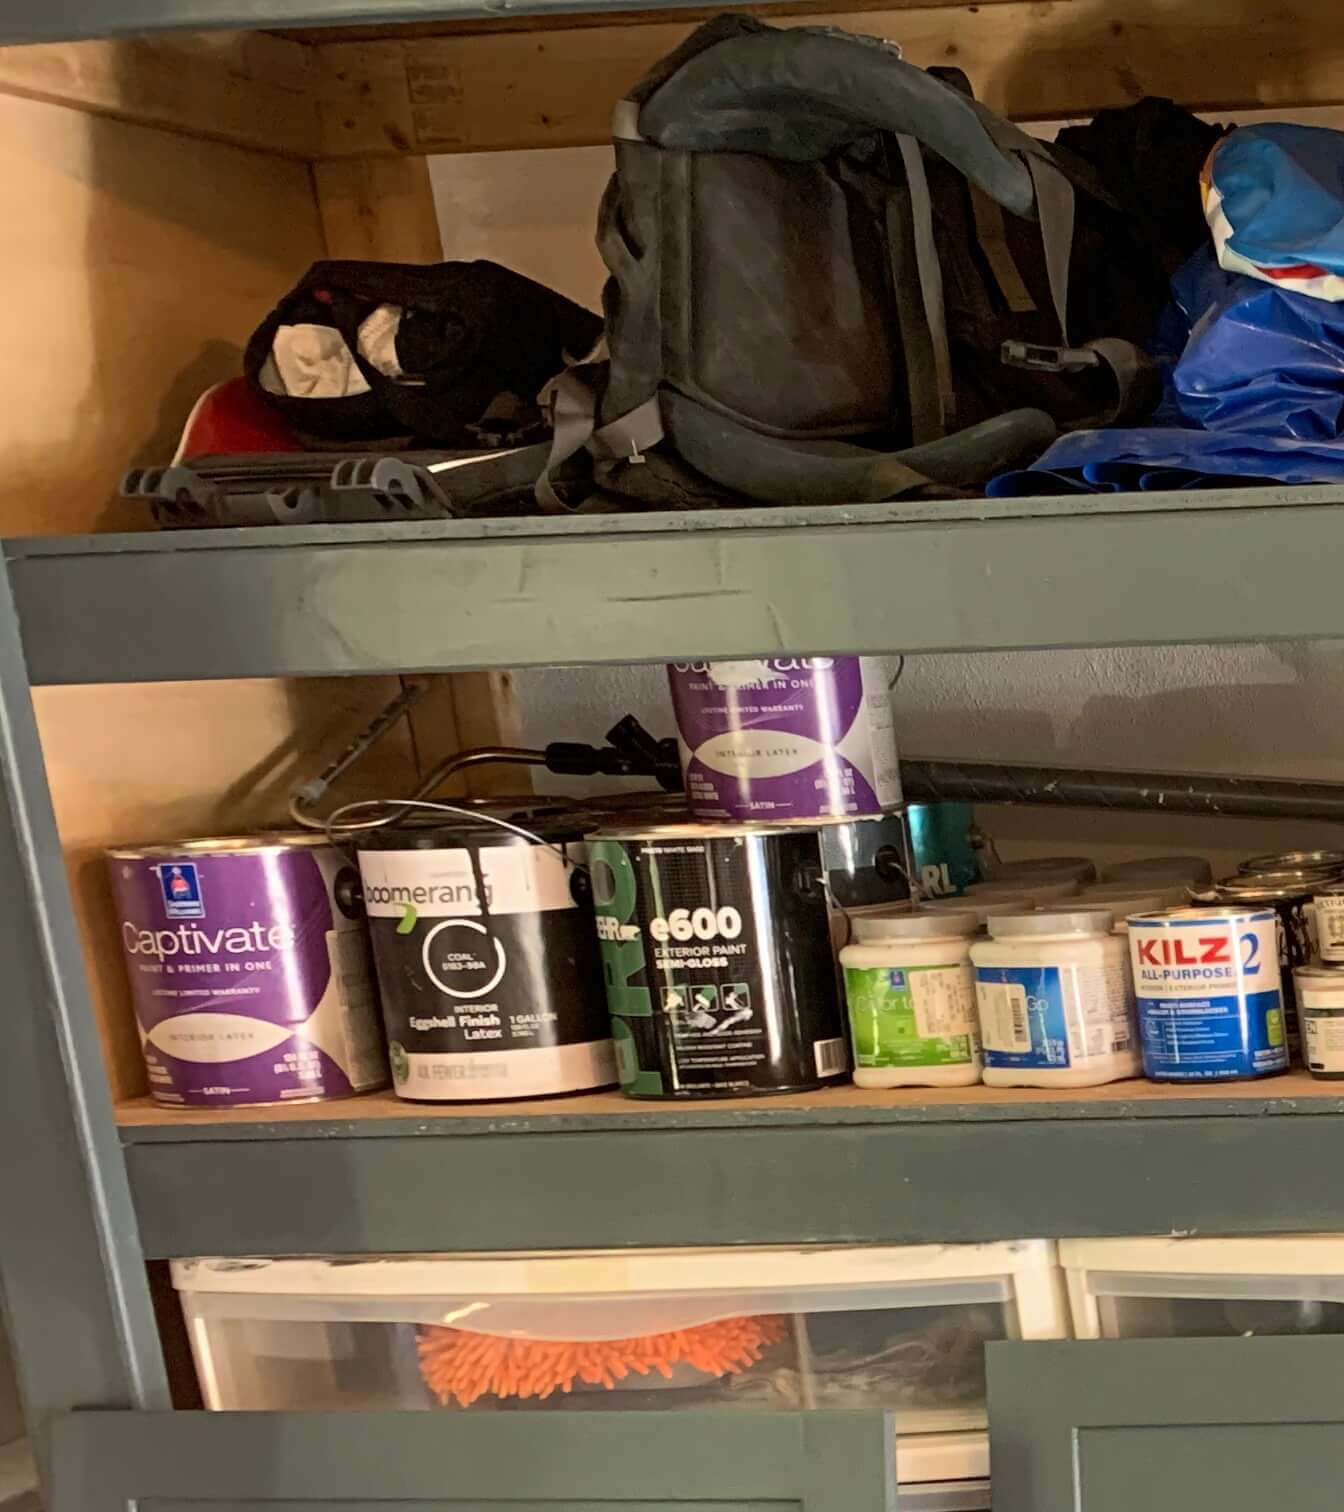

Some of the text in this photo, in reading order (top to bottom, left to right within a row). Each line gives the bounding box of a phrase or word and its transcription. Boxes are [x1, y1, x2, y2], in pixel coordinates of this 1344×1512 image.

[597, 916, 625, 941] EHR
[650, 906, 742, 941] e600
[122, 920, 294, 963] Captivate
[654, 944, 748, 959] EXTERIOR PAINT
[1136, 932, 1262, 977] KILZ 2
[178, 962, 221, 974] PRIMER
[225, 962, 241, 973] IN
[245, 960, 273, 971] ONE
[655, 957, 729, 970] SEMI-GLOSS
[1141, 967, 1233, 981] ALL-PURPOSE
[454, 1003, 499, 1014] INTERIOR
[409, 1014, 501, 1031] Eggshell Finish
[464, 1027, 503, 1041] Latex
